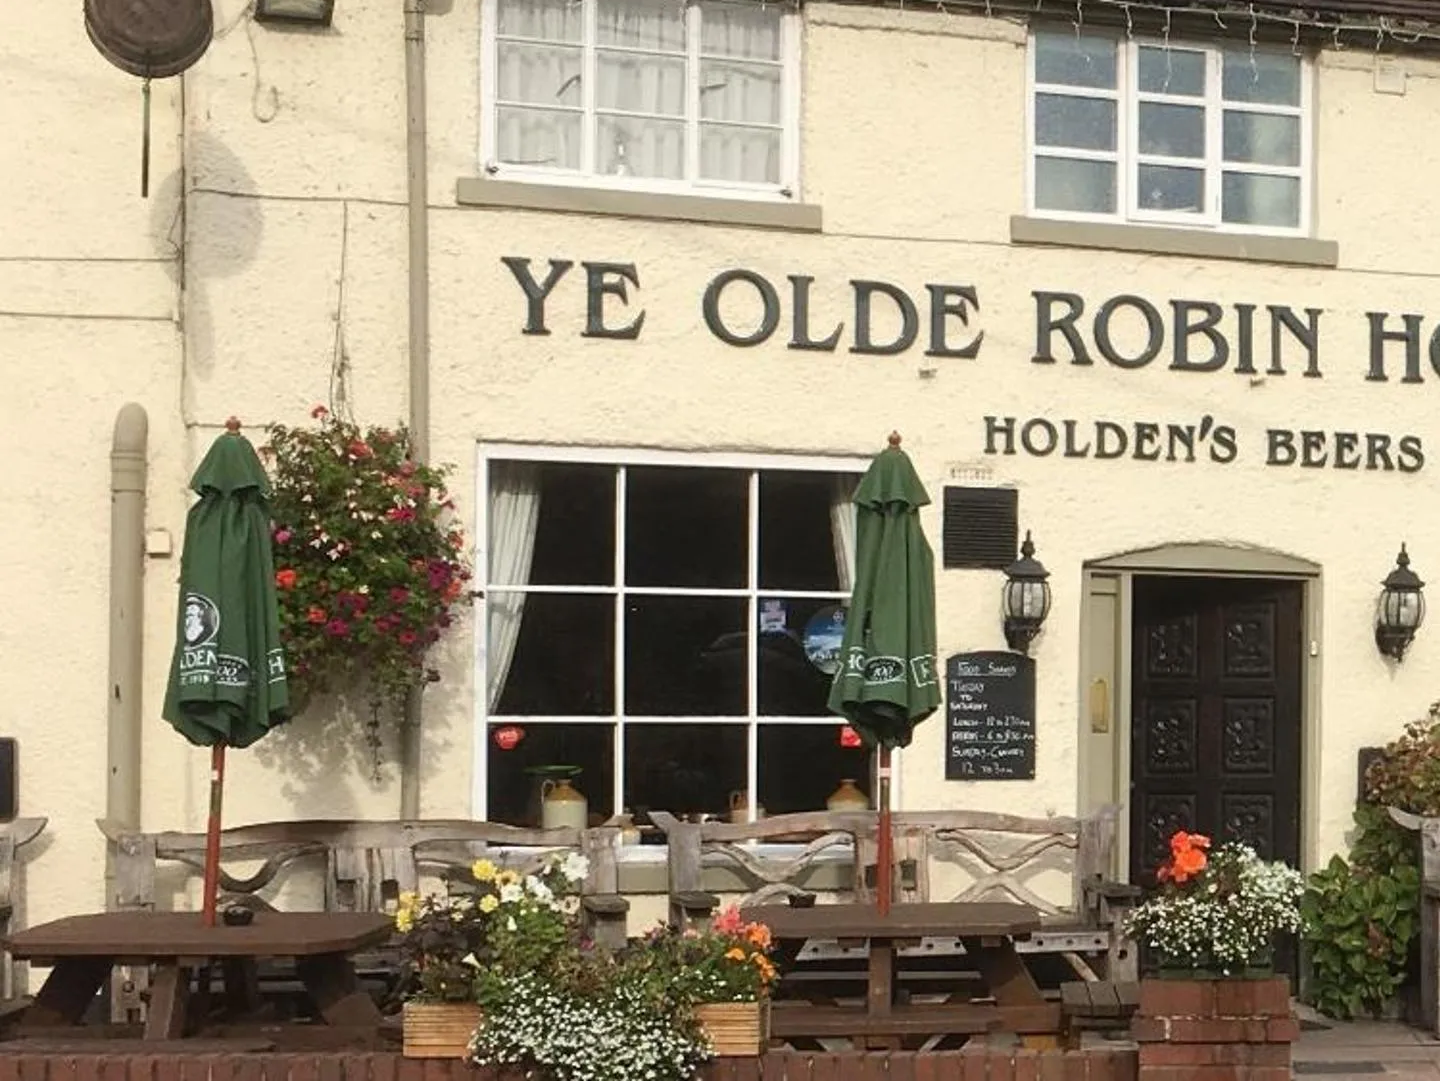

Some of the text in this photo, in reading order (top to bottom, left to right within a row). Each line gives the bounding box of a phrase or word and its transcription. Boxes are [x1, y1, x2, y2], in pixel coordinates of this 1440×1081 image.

[501, 256, 646, 340] YE
[702, 269, 984, 359] OLDE
[1031, 291, 1323, 377] ROBIN
[983, 415, 1426, 474] HOLDEN'S BEERS
